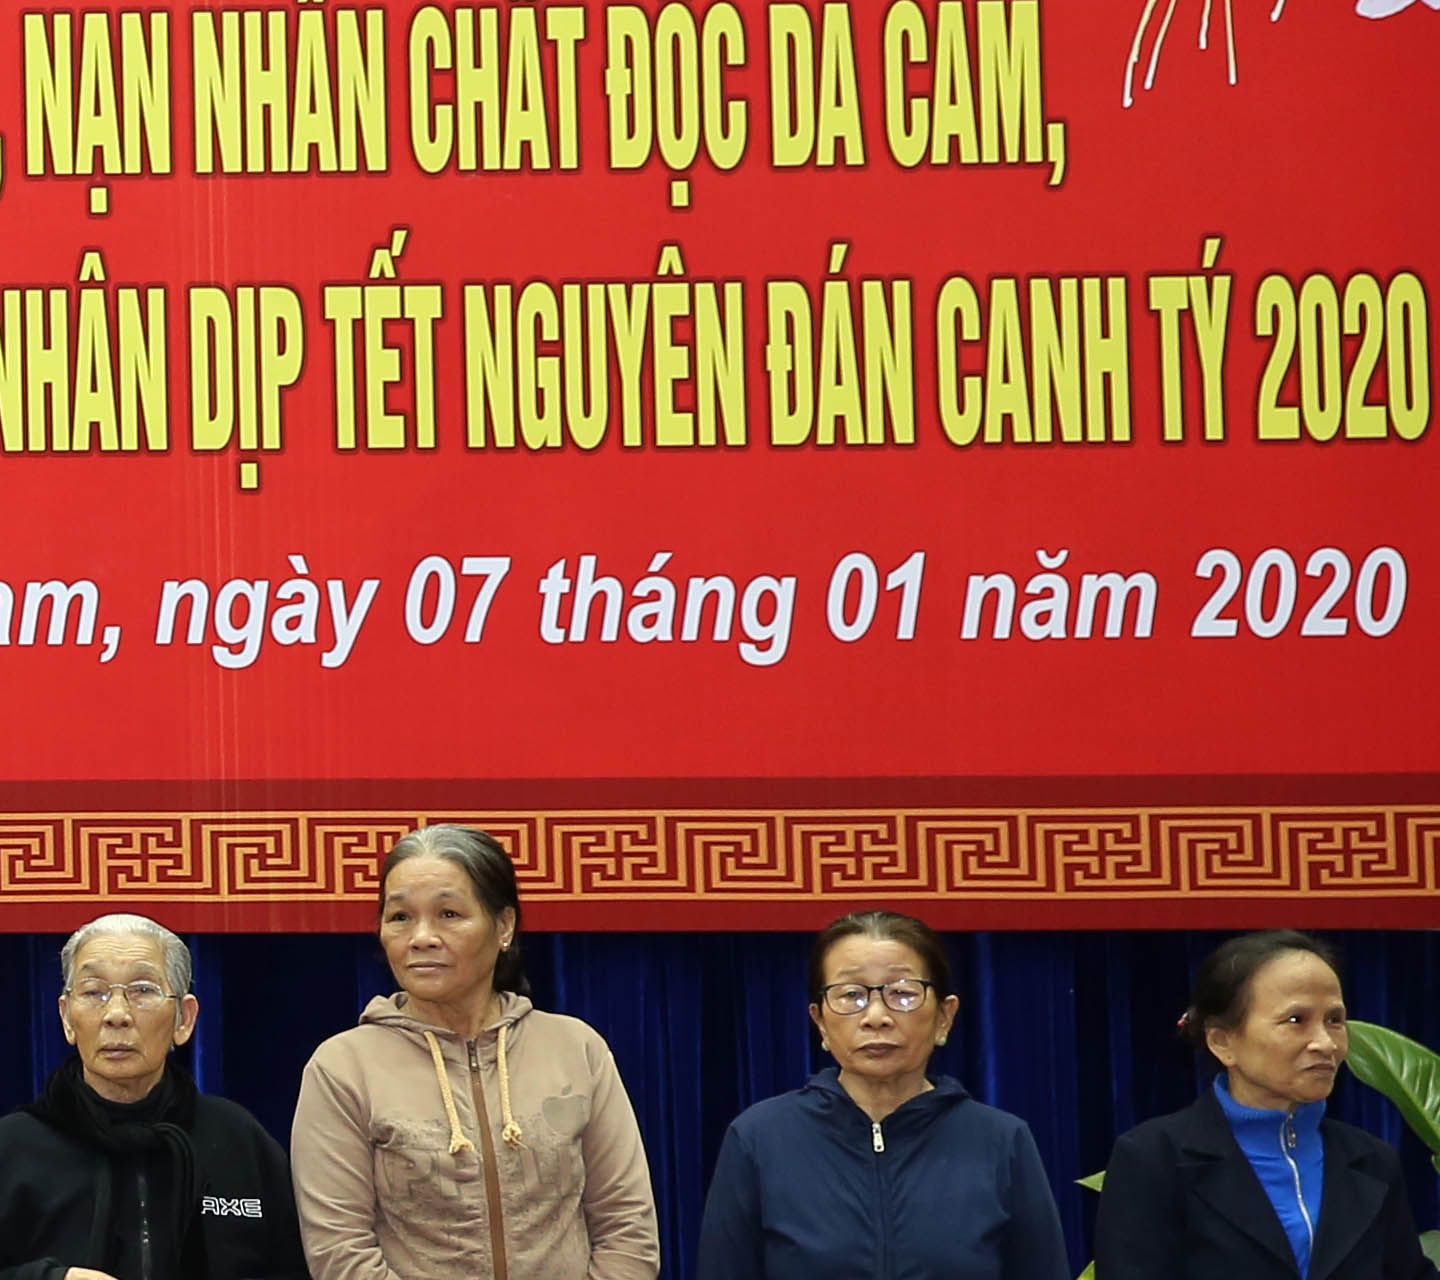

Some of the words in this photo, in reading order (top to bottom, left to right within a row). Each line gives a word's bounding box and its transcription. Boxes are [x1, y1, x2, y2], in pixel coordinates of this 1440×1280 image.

[24, 11, 171, 213] NẠN
[769, 3, 865, 166] DA
[884, 0, 1066, 185] CAM,
[189, 287, 303, 489] DỊP
[324, 230, 442, 449] TẾT
[464, 246, 746, 450] NGUYÊN
[766, 244, 915, 445] ĐÁN
[937, 277, 1130, 446] CANH
[1149, 238, 1231, 441] TÝ
[1256, 273, 1429, 441] 2020
[154, 554, 380, 669] ngày
[404, 555, 512, 645] 07
[537, 552, 798, 663] tháng
[826, 551, 926, 642] 01
[960, 549, 1157, 640] năm
[1190, 547, 1408, 638] 2020
[201, 1196, 263, 1218] AXE
